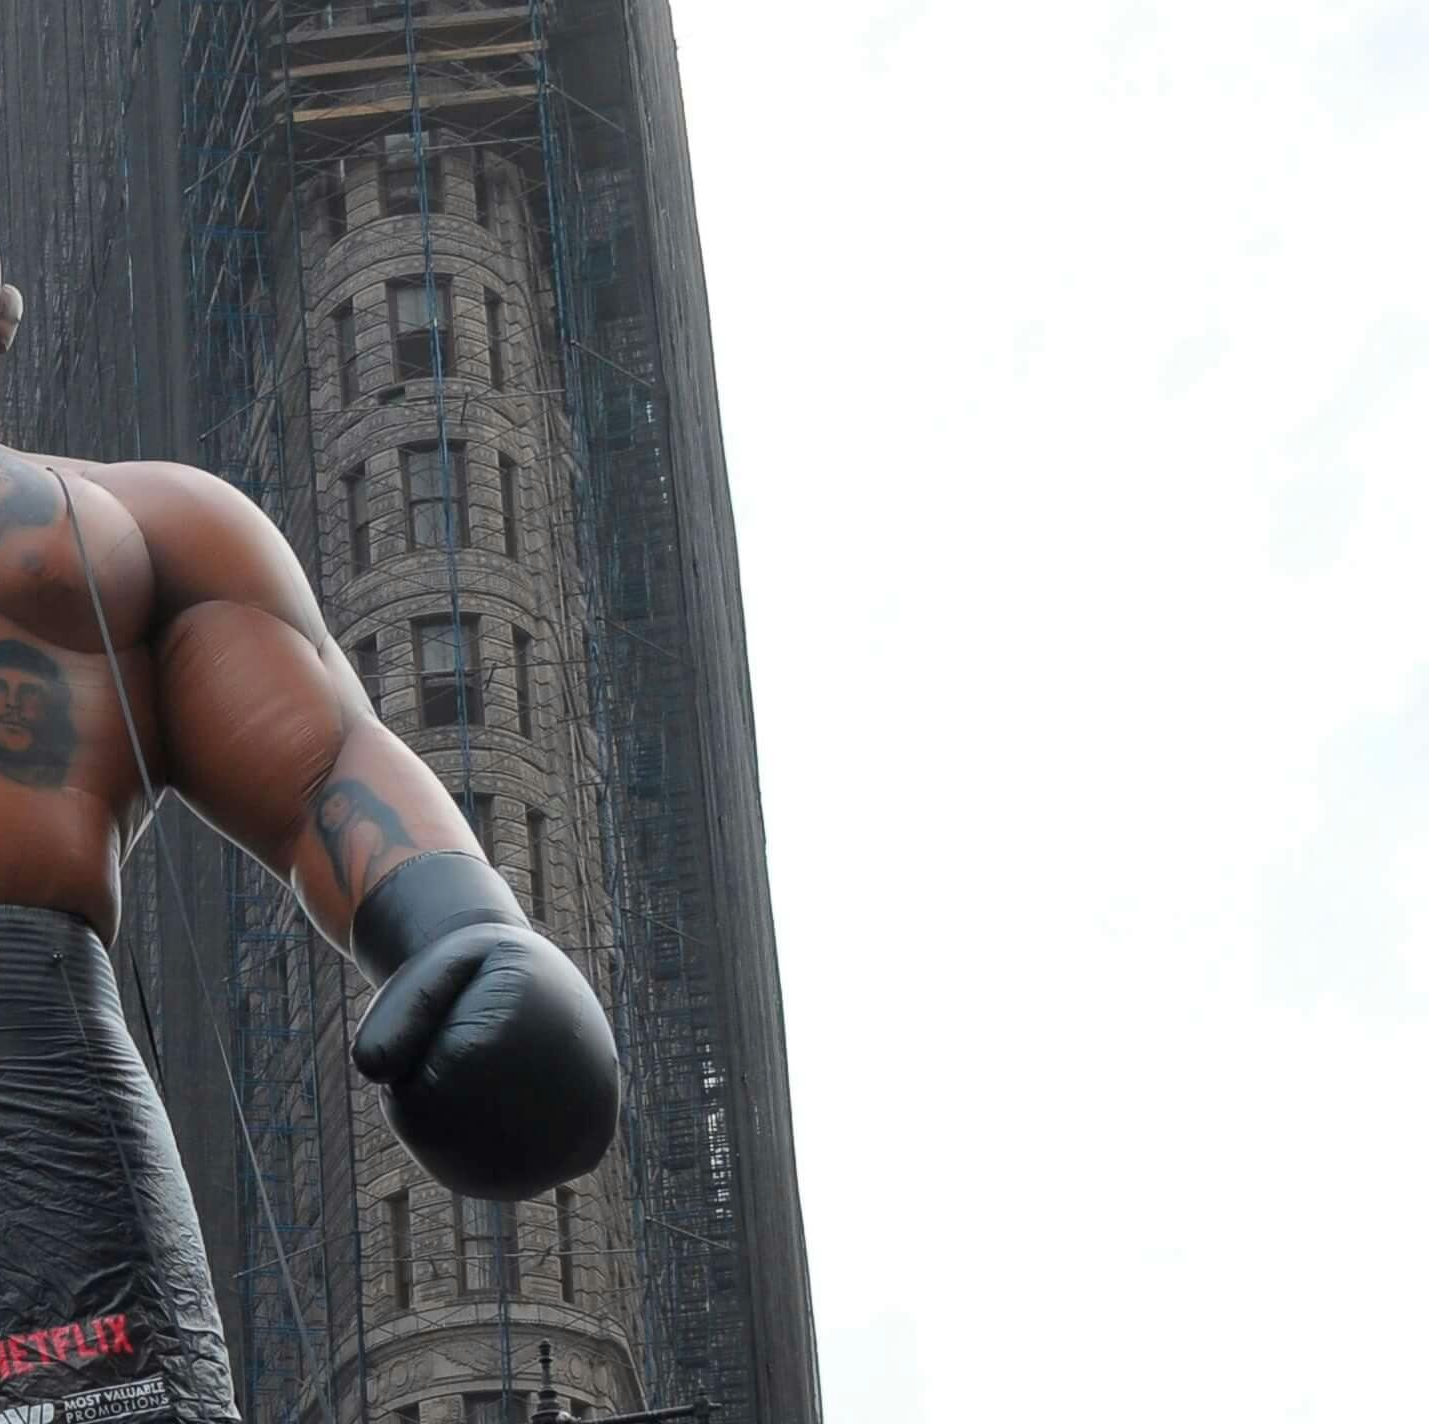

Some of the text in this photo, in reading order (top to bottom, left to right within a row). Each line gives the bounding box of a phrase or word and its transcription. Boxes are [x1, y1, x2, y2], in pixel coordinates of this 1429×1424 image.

[64, 1381, 166, 1411] MOST VALUABLE
[65, 1394, 170, 1424] PROMOTIONS
